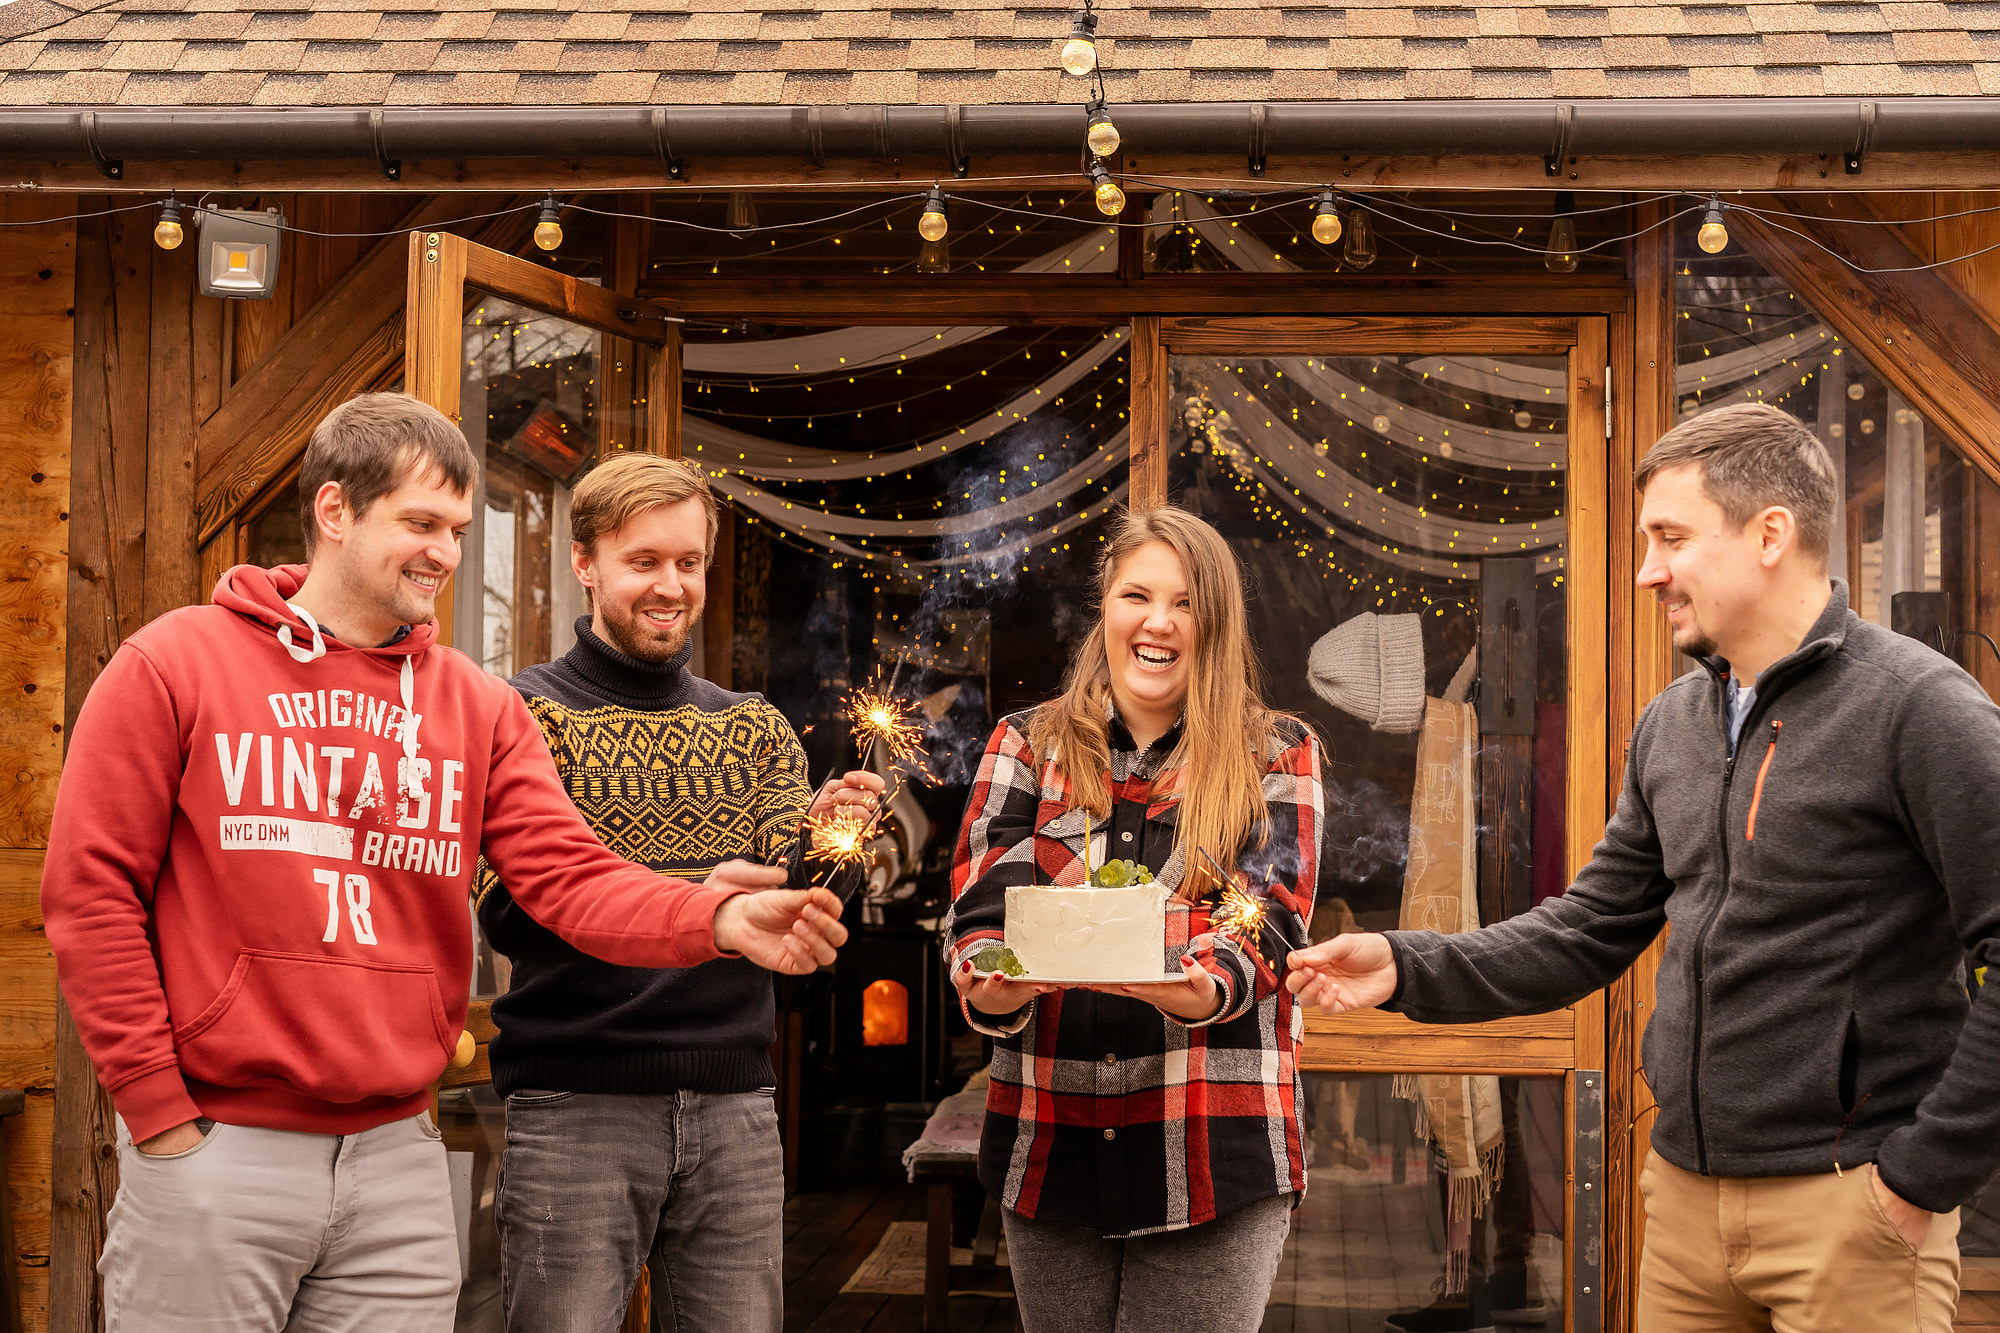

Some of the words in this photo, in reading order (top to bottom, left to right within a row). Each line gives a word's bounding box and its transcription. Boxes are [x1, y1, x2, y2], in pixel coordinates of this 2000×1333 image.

[215, 732, 464, 833] VINTAGE
[224, 822, 252, 841] NYC
[258, 824, 290, 842] DNM
[361, 830, 460, 877] BRAND
[313, 868, 378, 945] 78
